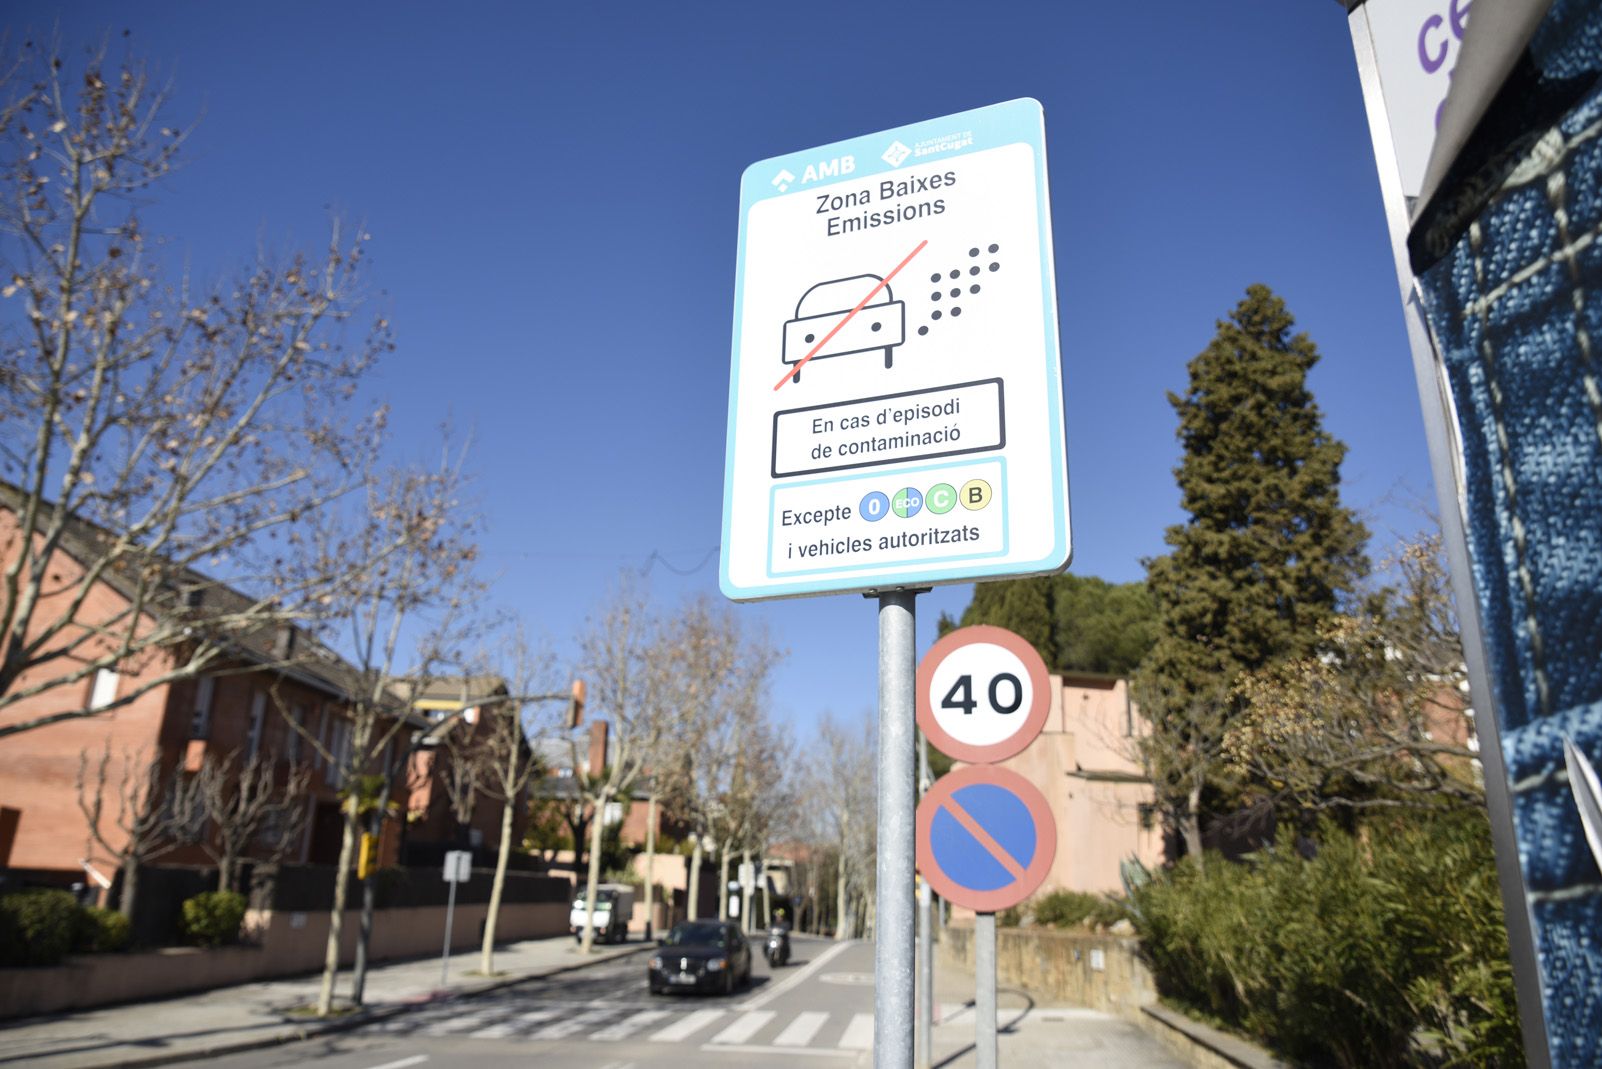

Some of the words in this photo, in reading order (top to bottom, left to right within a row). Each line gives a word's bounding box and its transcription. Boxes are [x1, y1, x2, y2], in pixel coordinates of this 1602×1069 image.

[801, 155, 856, 184] AMB
[816, 189, 871, 214] Zona
[879, 171, 956, 200] Baixes
[827, 199, 946, 237] Emissions
[811, 443, 833, 460] de
[838, 423, 961, 455] contaminació
[812, 418, 834, 434] En
[840, 414, 870, 430] cas
[782, 505, 852, 526] Excepte
[868, 498, 880, 516] 0
[895, 497, 919, 508] ECO
[933, 490, 949, 508] C
[968, 487, 983, 504] B
[788, 543, 792, 559] i
[798, 536, 872, 558] vehicles
[879, 524, 980, 550] autoritzats
[941, 672, 1023, 714] 40
